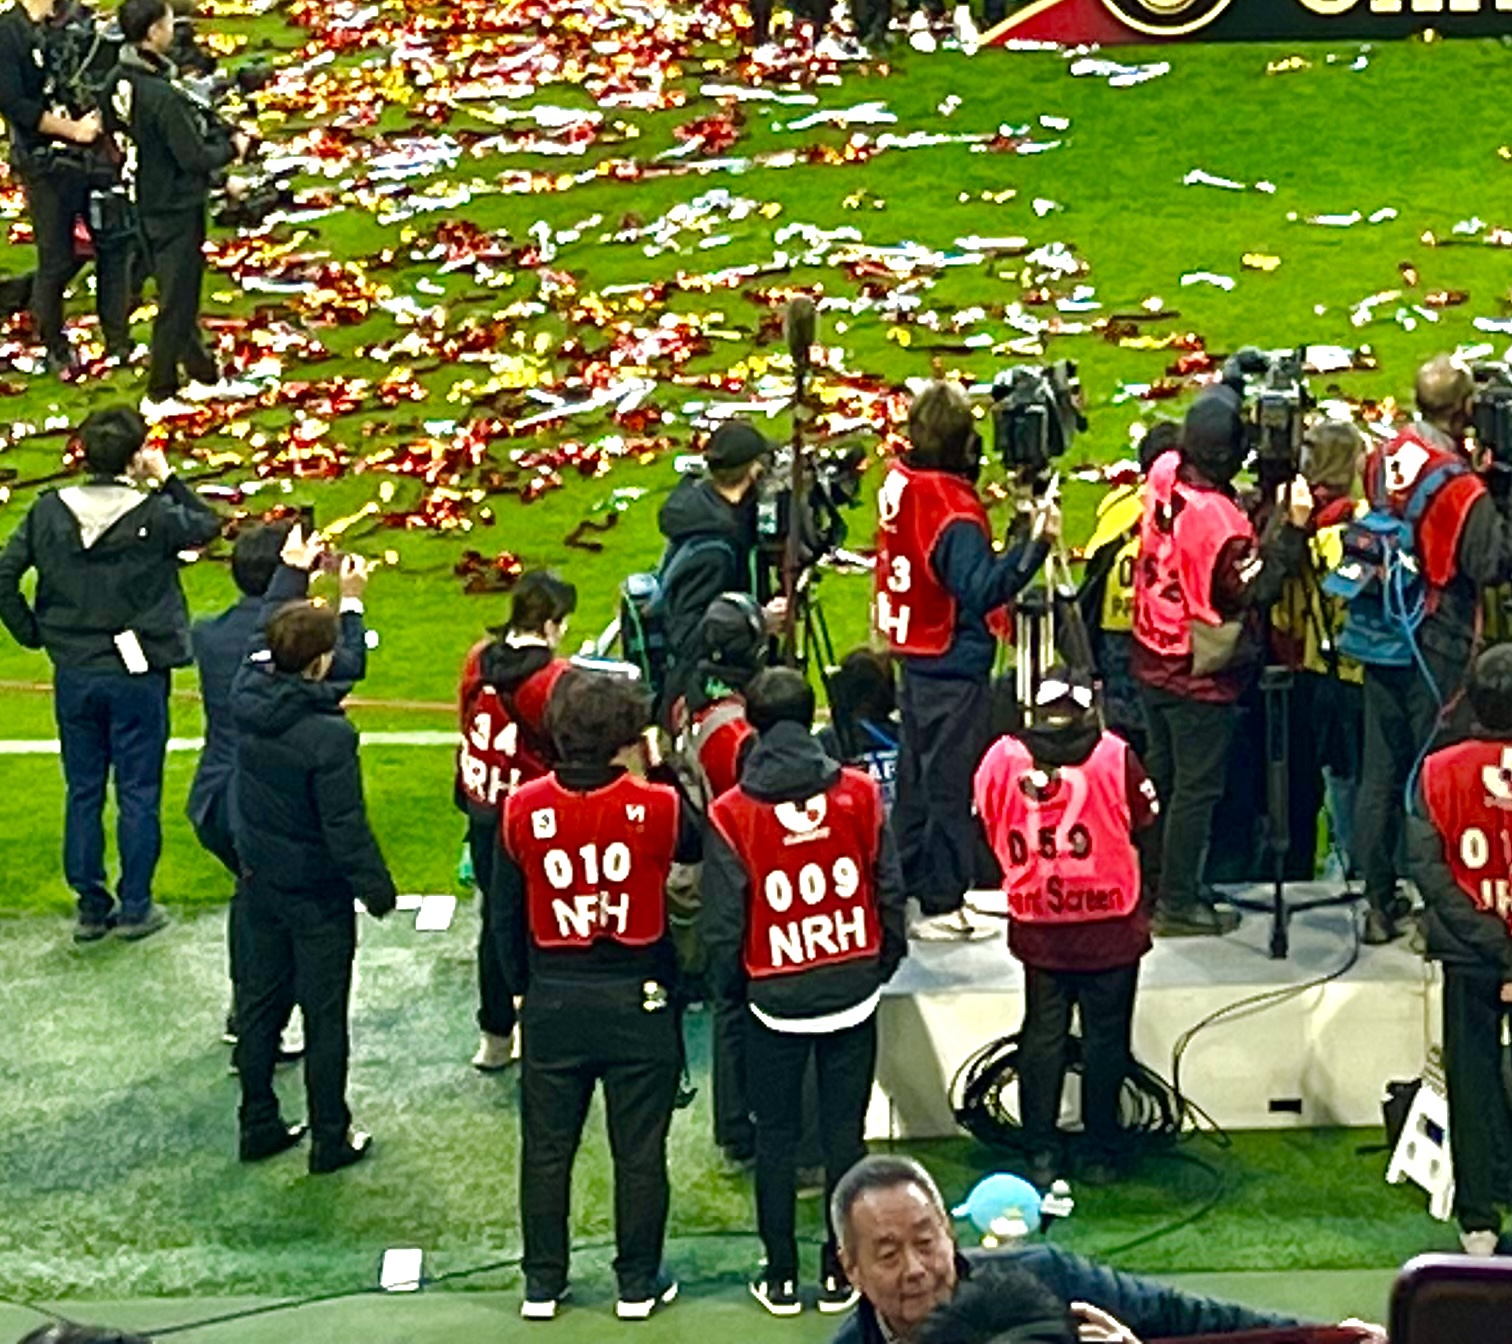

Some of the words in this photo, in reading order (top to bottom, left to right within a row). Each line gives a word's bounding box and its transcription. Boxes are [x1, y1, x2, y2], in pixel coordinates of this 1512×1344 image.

[543, 841, 632, 890] 010
[764, 856, 861, 913] 009
[1045, 874, 1125, 914] Screen
[767, 905, 869, 968] NRH
